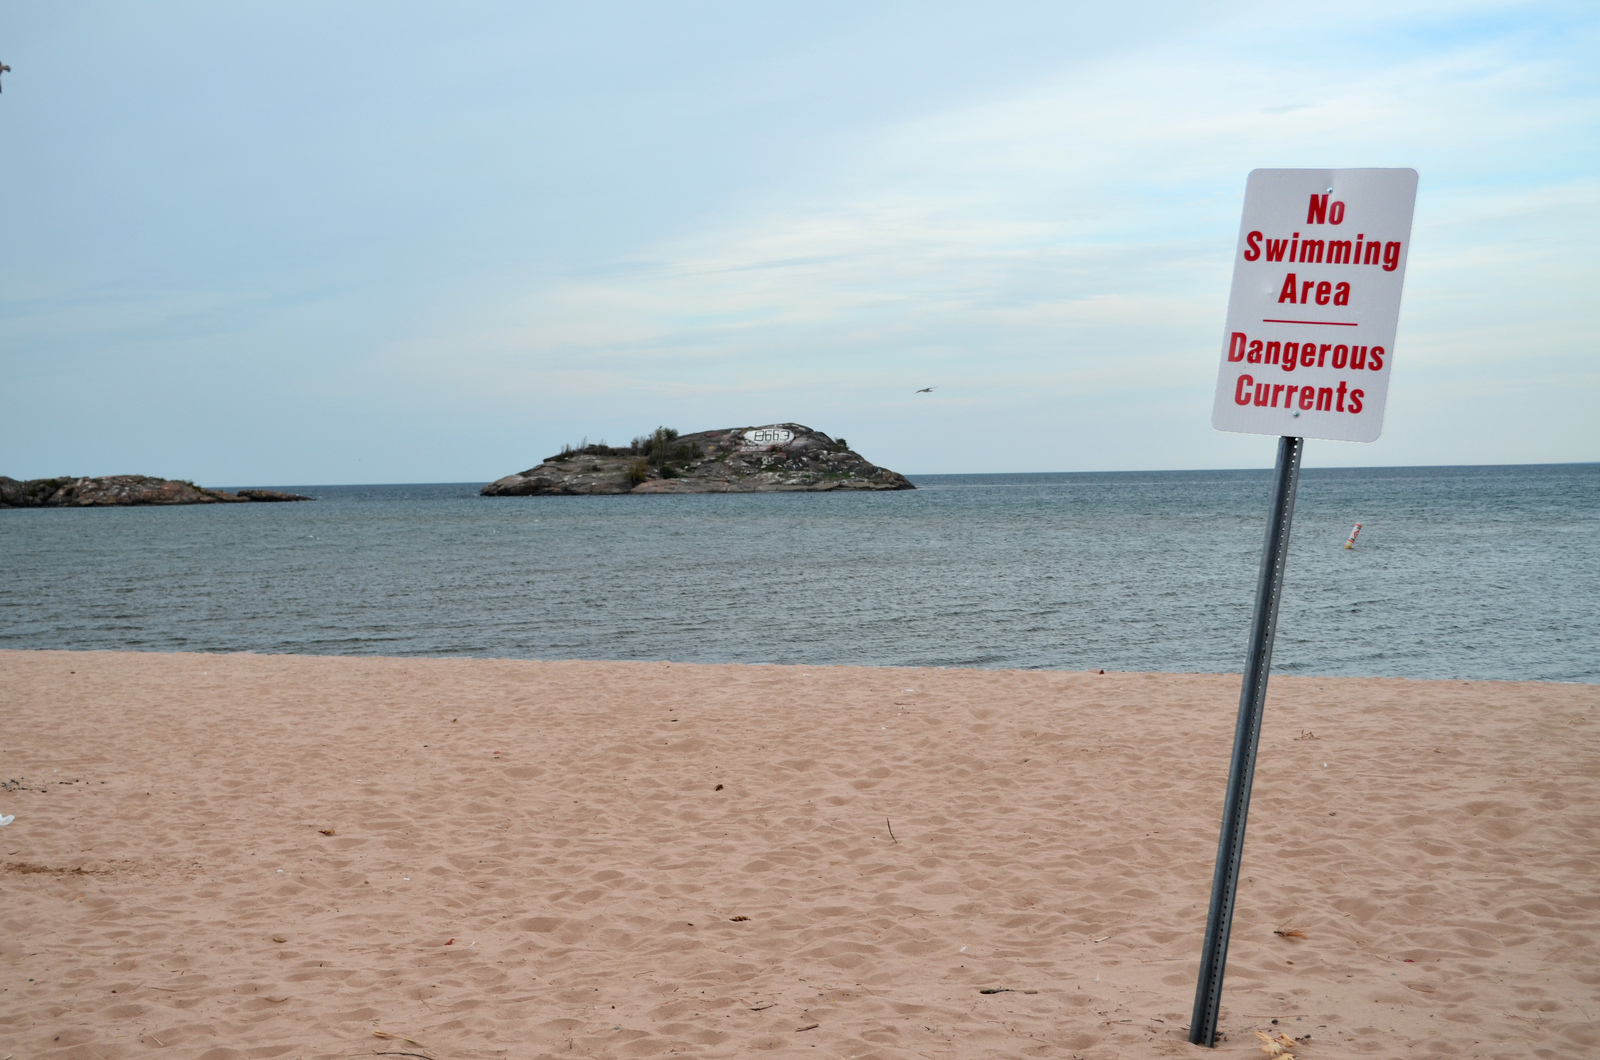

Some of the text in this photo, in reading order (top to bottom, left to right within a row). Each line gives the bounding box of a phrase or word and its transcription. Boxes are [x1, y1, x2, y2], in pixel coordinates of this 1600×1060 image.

[1306, 193, 1346, 226] No
[1244, 230, 1402, 272] Swimming
[1278, 272, 1351, 306] Area
[1228, 331, 1385, 371] Dangerous
[1234, 374, 1365, 414] Currents
